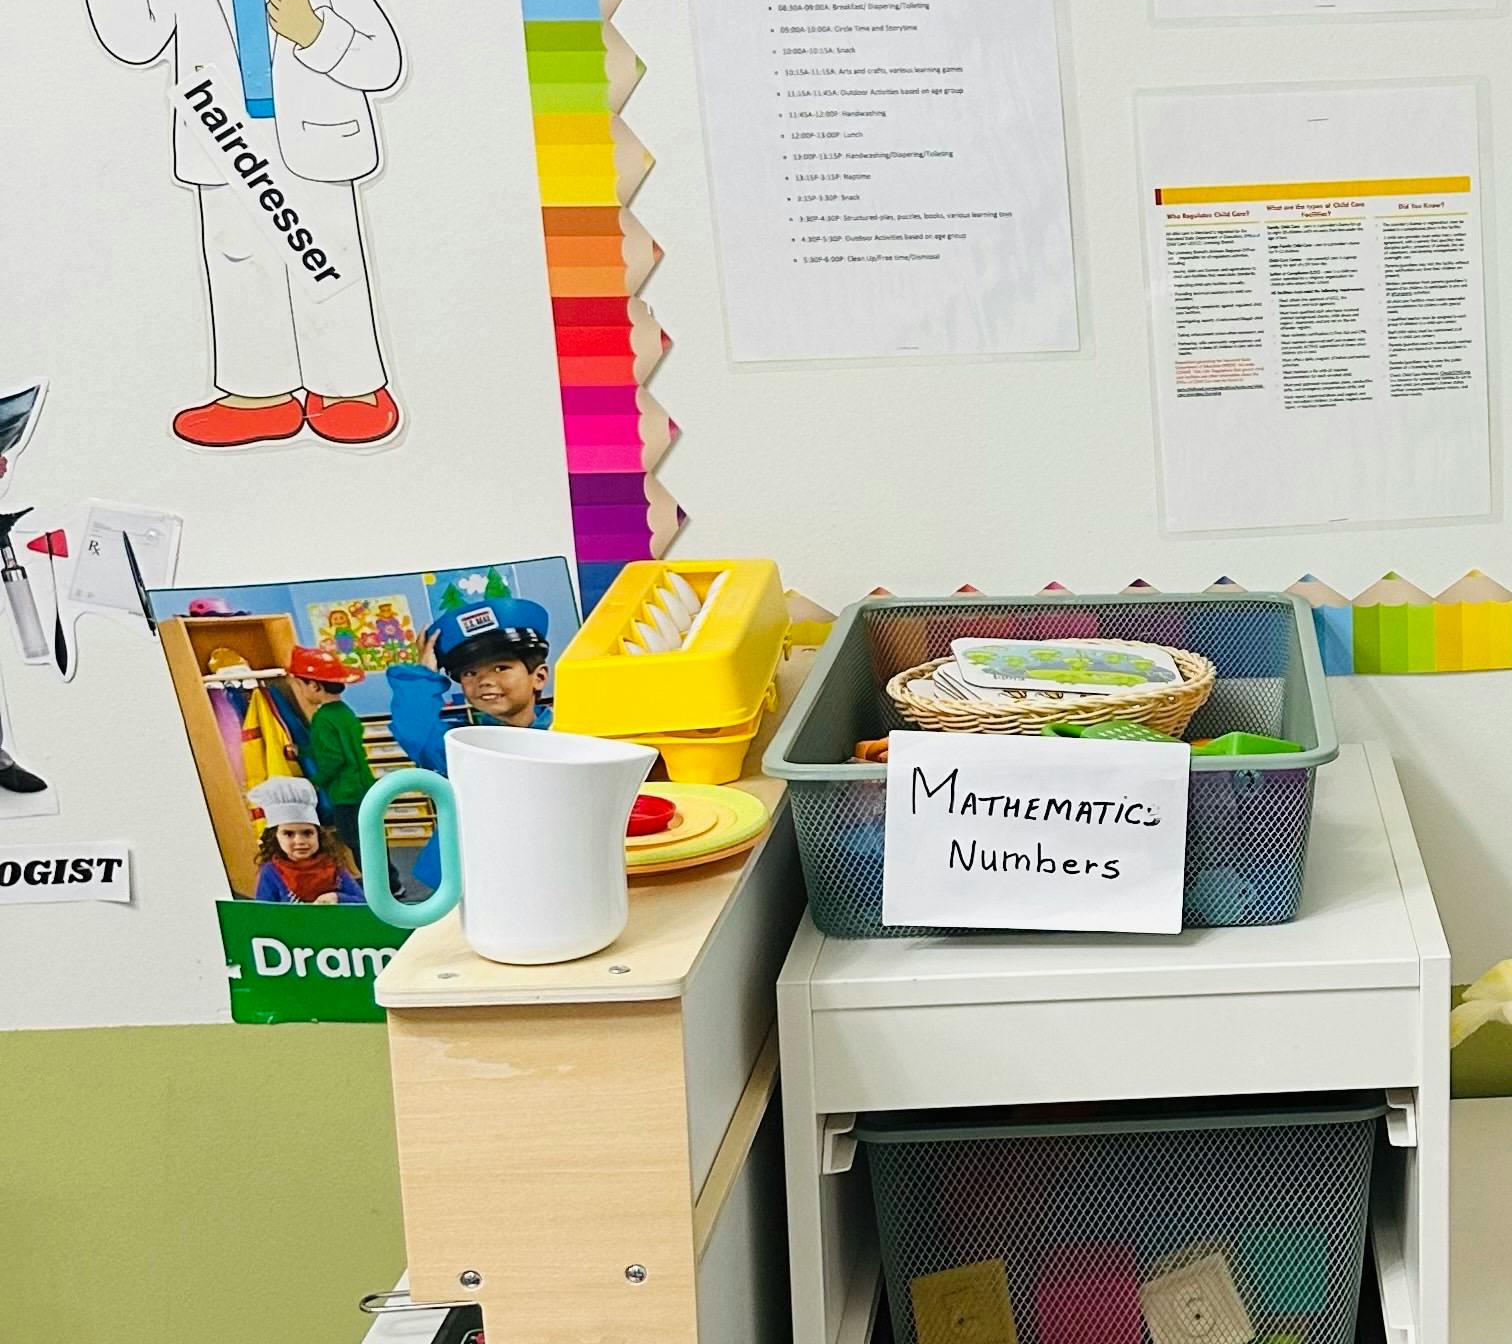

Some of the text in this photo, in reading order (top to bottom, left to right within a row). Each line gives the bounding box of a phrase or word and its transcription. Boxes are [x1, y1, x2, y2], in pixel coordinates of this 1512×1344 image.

[184, 79, 341, 282] hairdresser
[0, 858, 123, 887] OGIST
[949, 839, 1120, 880] Numbers
[251, 937, 400, 978] Dram
